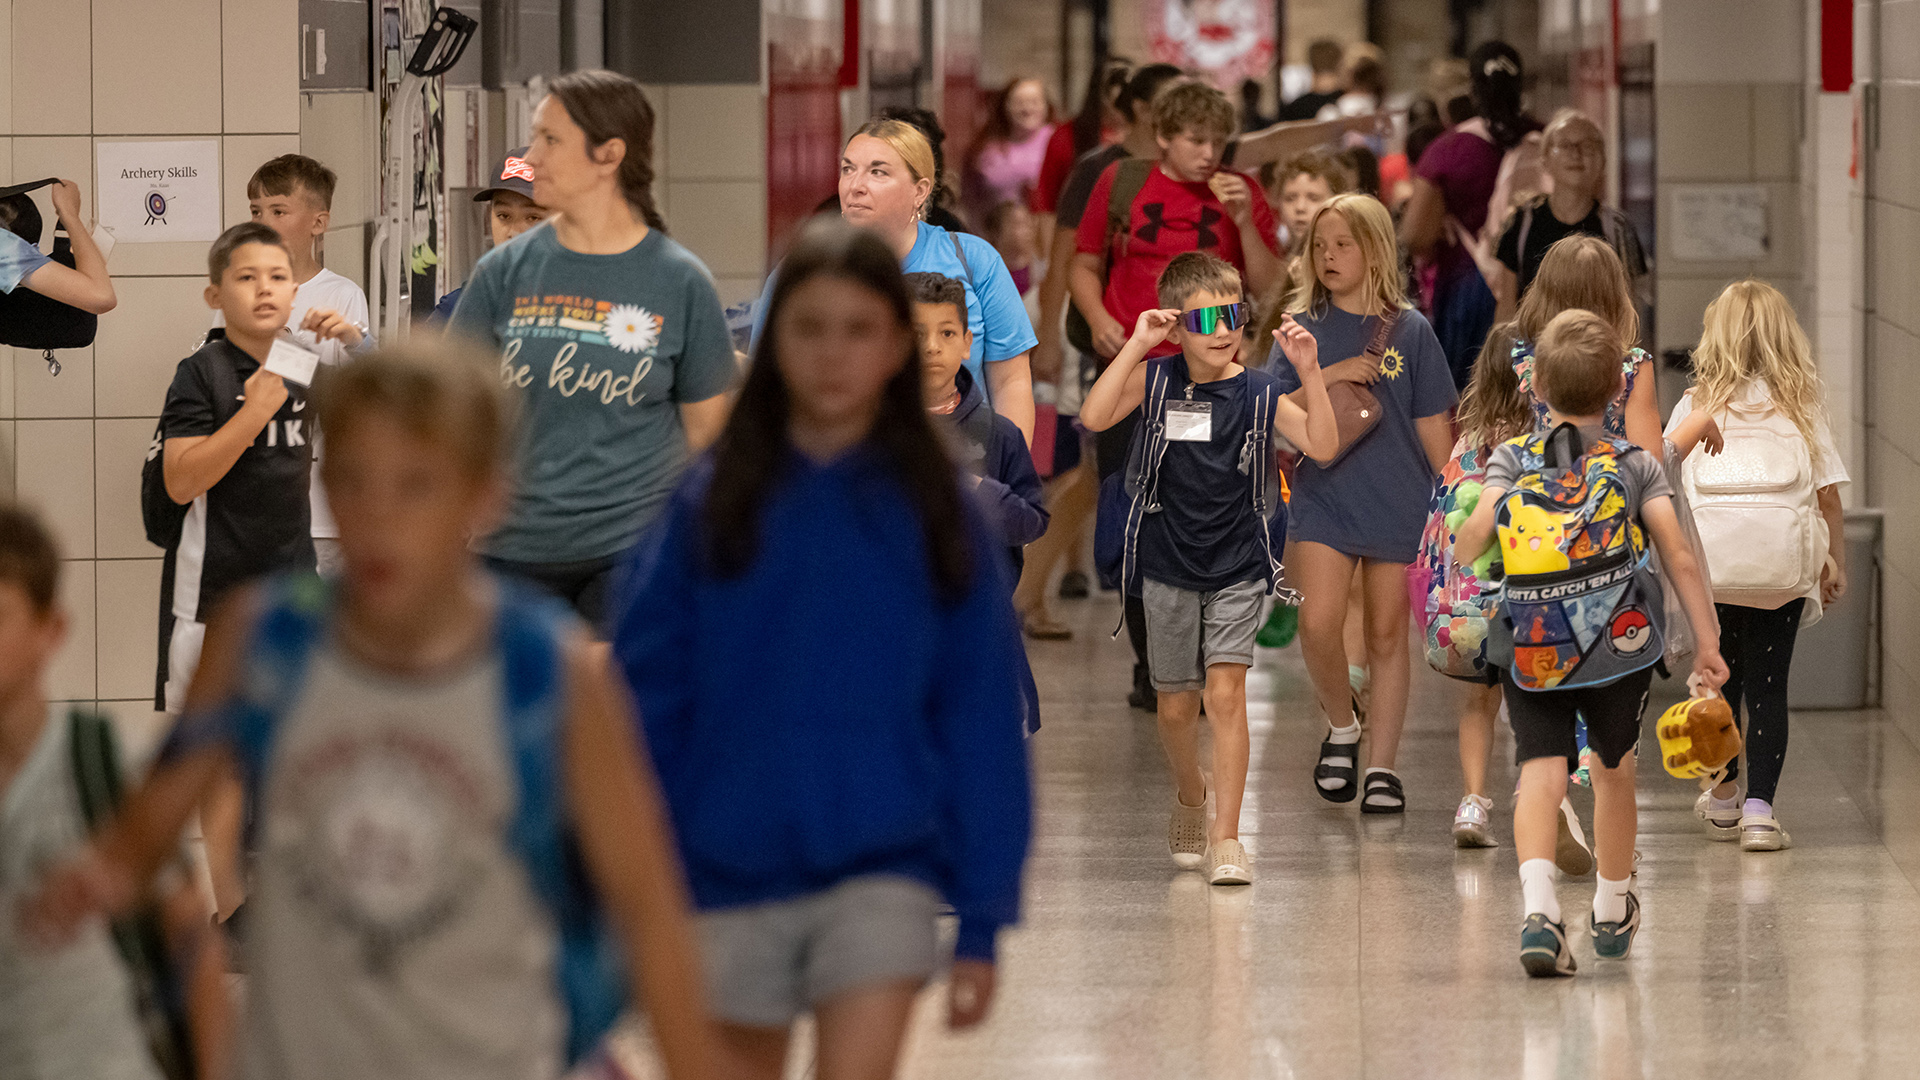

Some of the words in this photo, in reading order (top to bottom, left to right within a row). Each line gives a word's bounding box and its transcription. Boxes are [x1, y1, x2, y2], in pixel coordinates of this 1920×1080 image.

[120, 167, 165, 181] Archery
[167, 166, 198, 178] Skills
[543, 295, 594, 309] WORLD
[513, 305, 558, 317] WHERE
[563, 306, 595, 321] YOU
[508, 316, 537, 328] CAN
[538, 316, 557, 327] BE
[504, 327, 578, 341] ANYTHING
[500, 338, 535, 390] be
[548, 341, 654, 407] kind
[267, 419, 312, 447] IK
[1506, 588, 1539, 601] GOTTA
[1540, 581, 1586, 599] CATCH
[1588, 573, 1612, 589] 'EM
